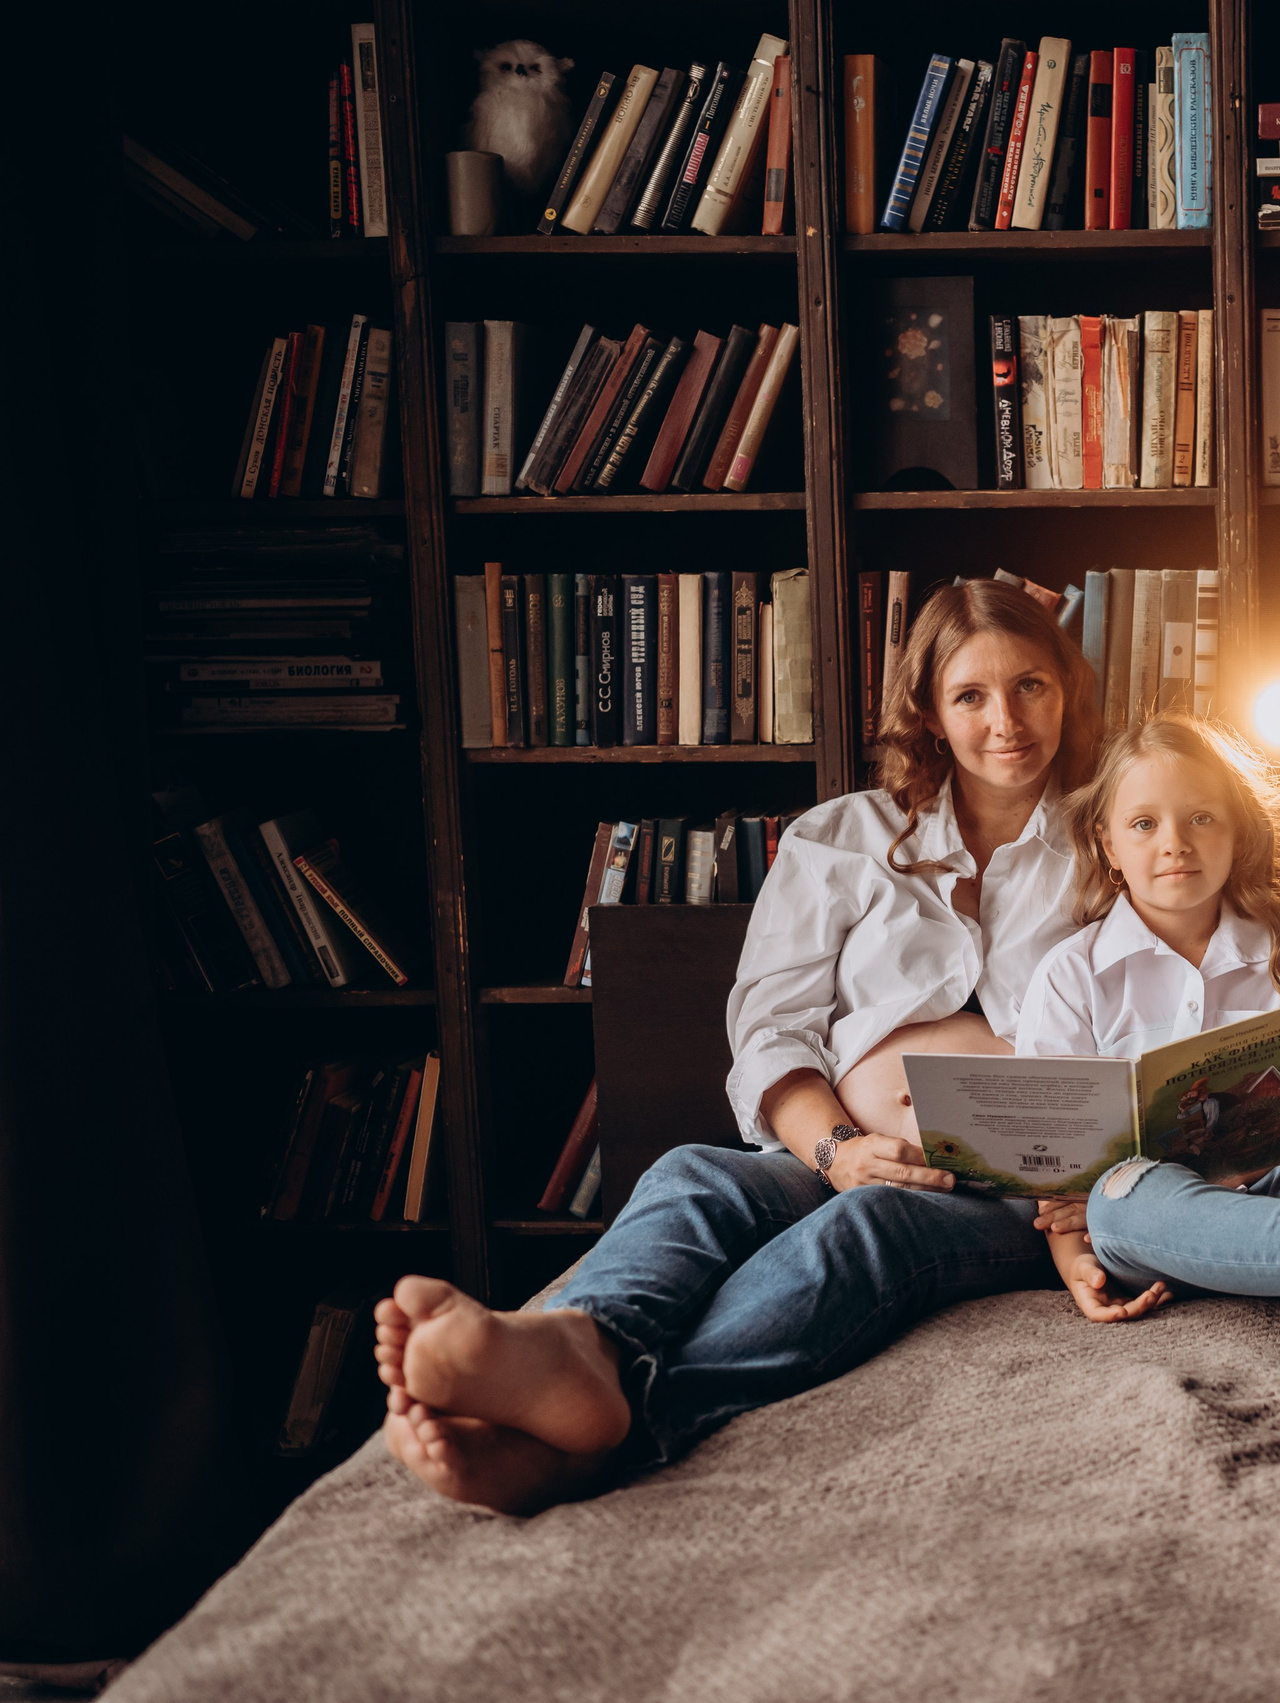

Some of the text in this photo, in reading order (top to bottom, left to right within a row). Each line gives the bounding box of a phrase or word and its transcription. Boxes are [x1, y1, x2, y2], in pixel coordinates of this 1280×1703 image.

[927, 78, 939, 98] НОЧИ
[1189, 59, 1197, 110] РАССКАЗОВ
[613, 88, 634, 124] ОРЛОВ
[960, 100, 977, 132] WARS
[1188, 113, 1198, 170] БИБЛЕЙСКИХ
[668, 132, 710, 222] ПОЛИНА ДАШКОВА
[1001, 140, 1016, 193] КОНСТАНТИН
[1006, 141, 1022, 200] ПАУСТОВСКИЙ
[255, 397, 272, 444] ДОНСКАЯ
[492, 406, 500, 448] СПАРТАК
[609, 452, 622, 465] НЕ
[615, 434, 632, 454] ЧЕГО
[246, 449, 260, 487] Н. Сухов
[597, 463, 616, 487] БЫЛО
[629, 585, 644, 662] СТРАШНЫЙ СУД
[288, 665, 351, 676] БИОЛОГИЯ
[508, 658, 517, 691] ГОГОЛЬ
[555, 678, 566, 723] АХУНОВ
[634, 691, 642, 730] АЛЕКСЕЙ
[274, 850, 321, 941] Александр Твардовский
[338, 908, 365, 938] ПОЛНЫЙ
[362, 937, 400, 980] СПРАВОЧНИК
[1192, 1054, 1223, 1069] КАК
